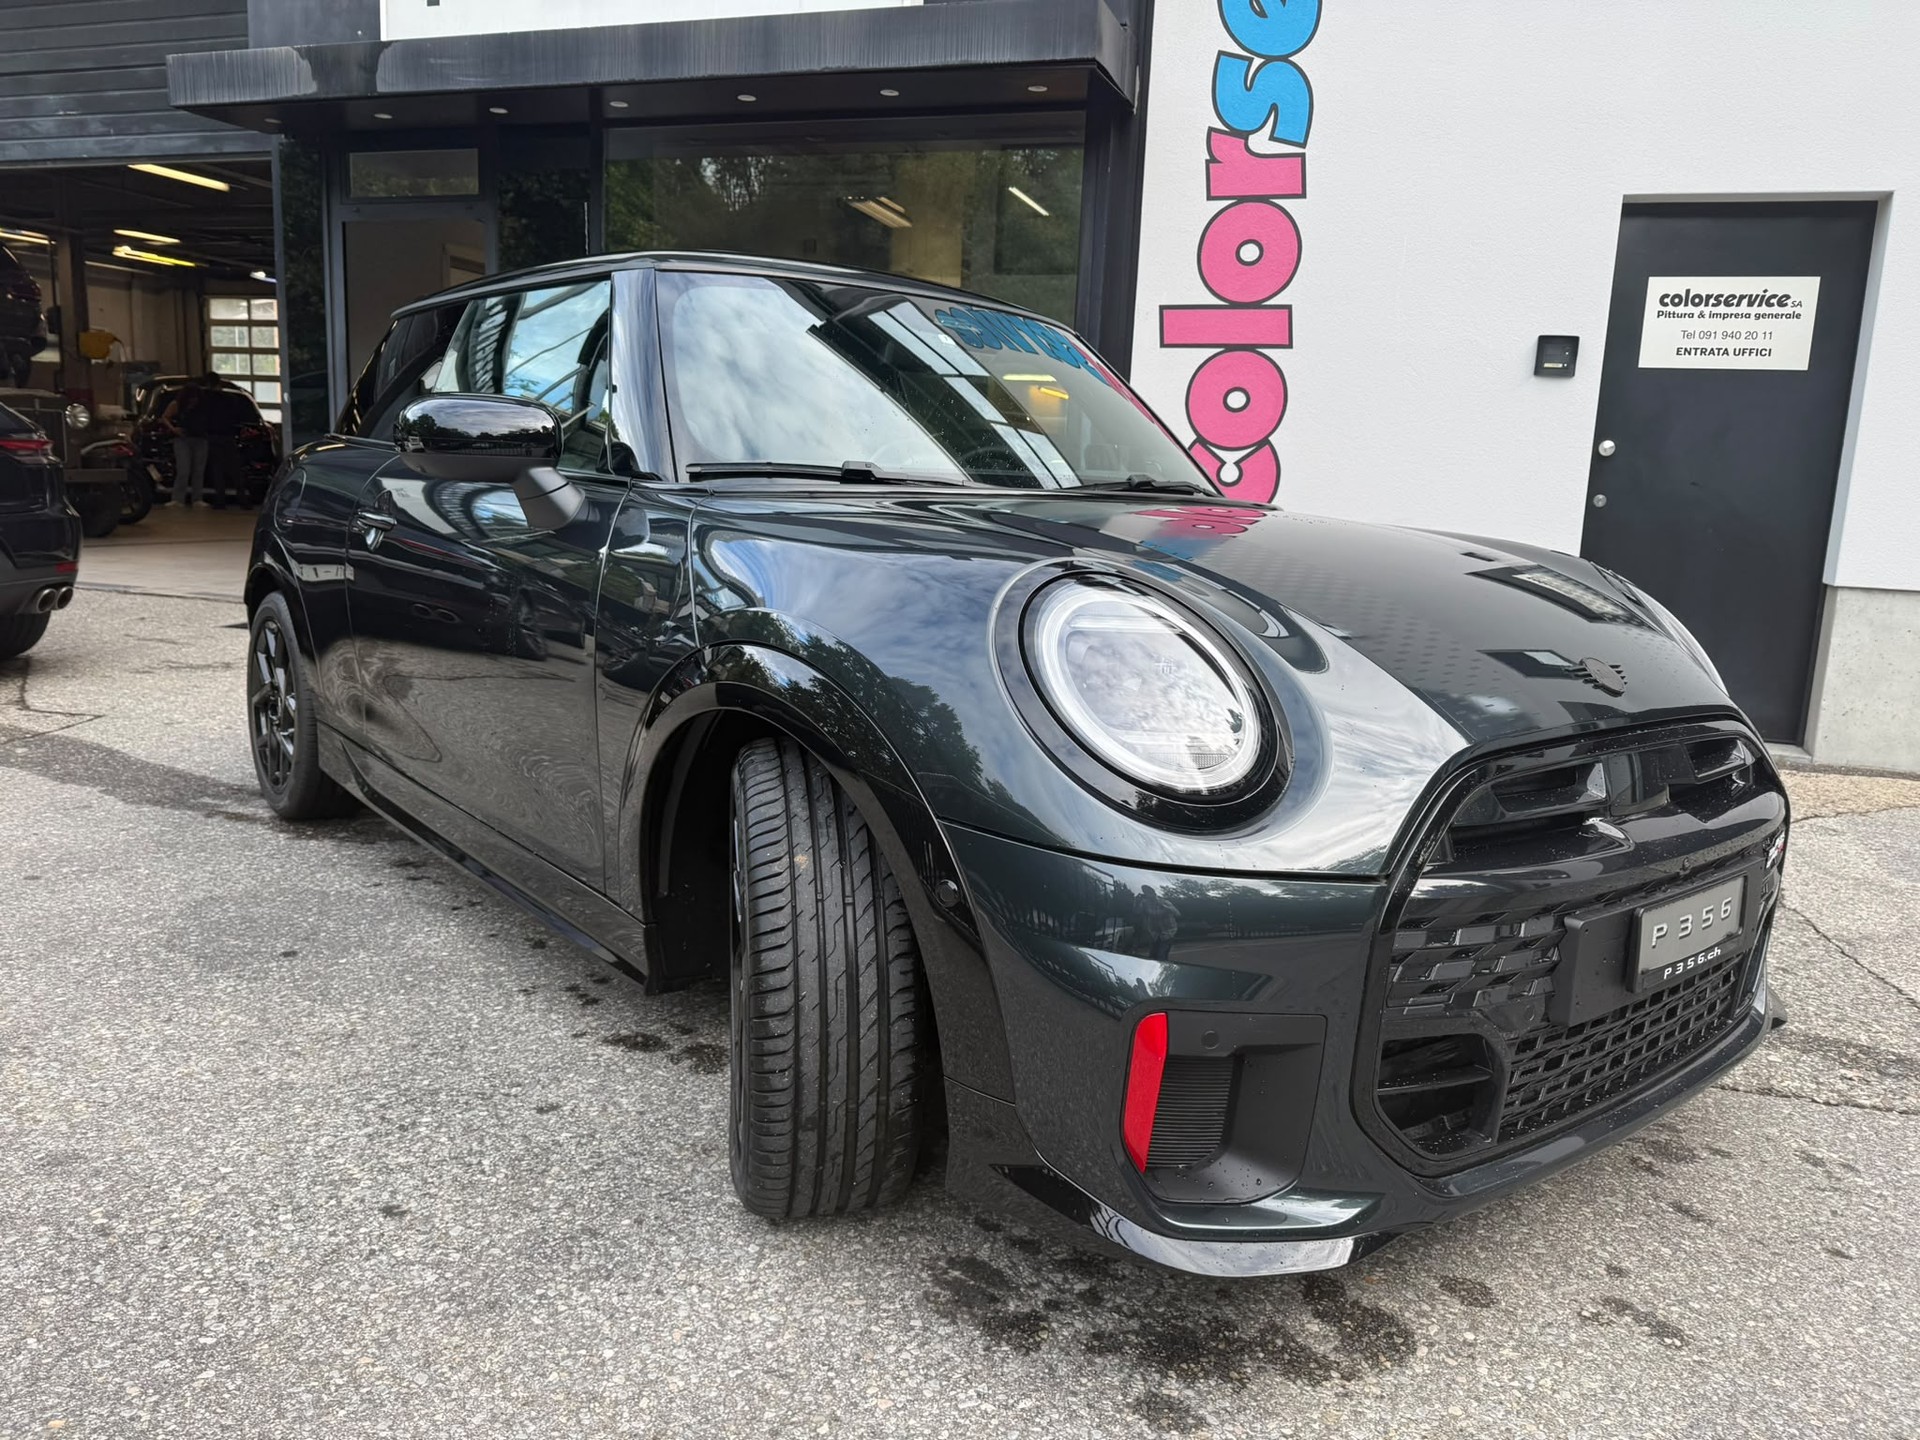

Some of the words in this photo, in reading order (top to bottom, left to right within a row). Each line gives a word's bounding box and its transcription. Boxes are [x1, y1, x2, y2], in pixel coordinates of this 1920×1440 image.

[1658, 288, 1791, 308] colorservice
[1790, 300, 1803, 309] SA
[1656, 310, 1695, 319] Pittura
[1697, 310, 1706, 319] &
[1708, 310, 1752, 321] impresa
[1753, 311, 1802, 321] generale
[1680, 329, 1697, 340] Tel
[1698, 330, 1718, 340] 091
[1720, 330, 1742, 341] 940
[1744, 330, 1759, 341] 20
[1761, 330, 1773, 341] 11
[1675, 347, 1730, 357] ENTRATA
[1732, 347, 1772, 357] UFFICI
